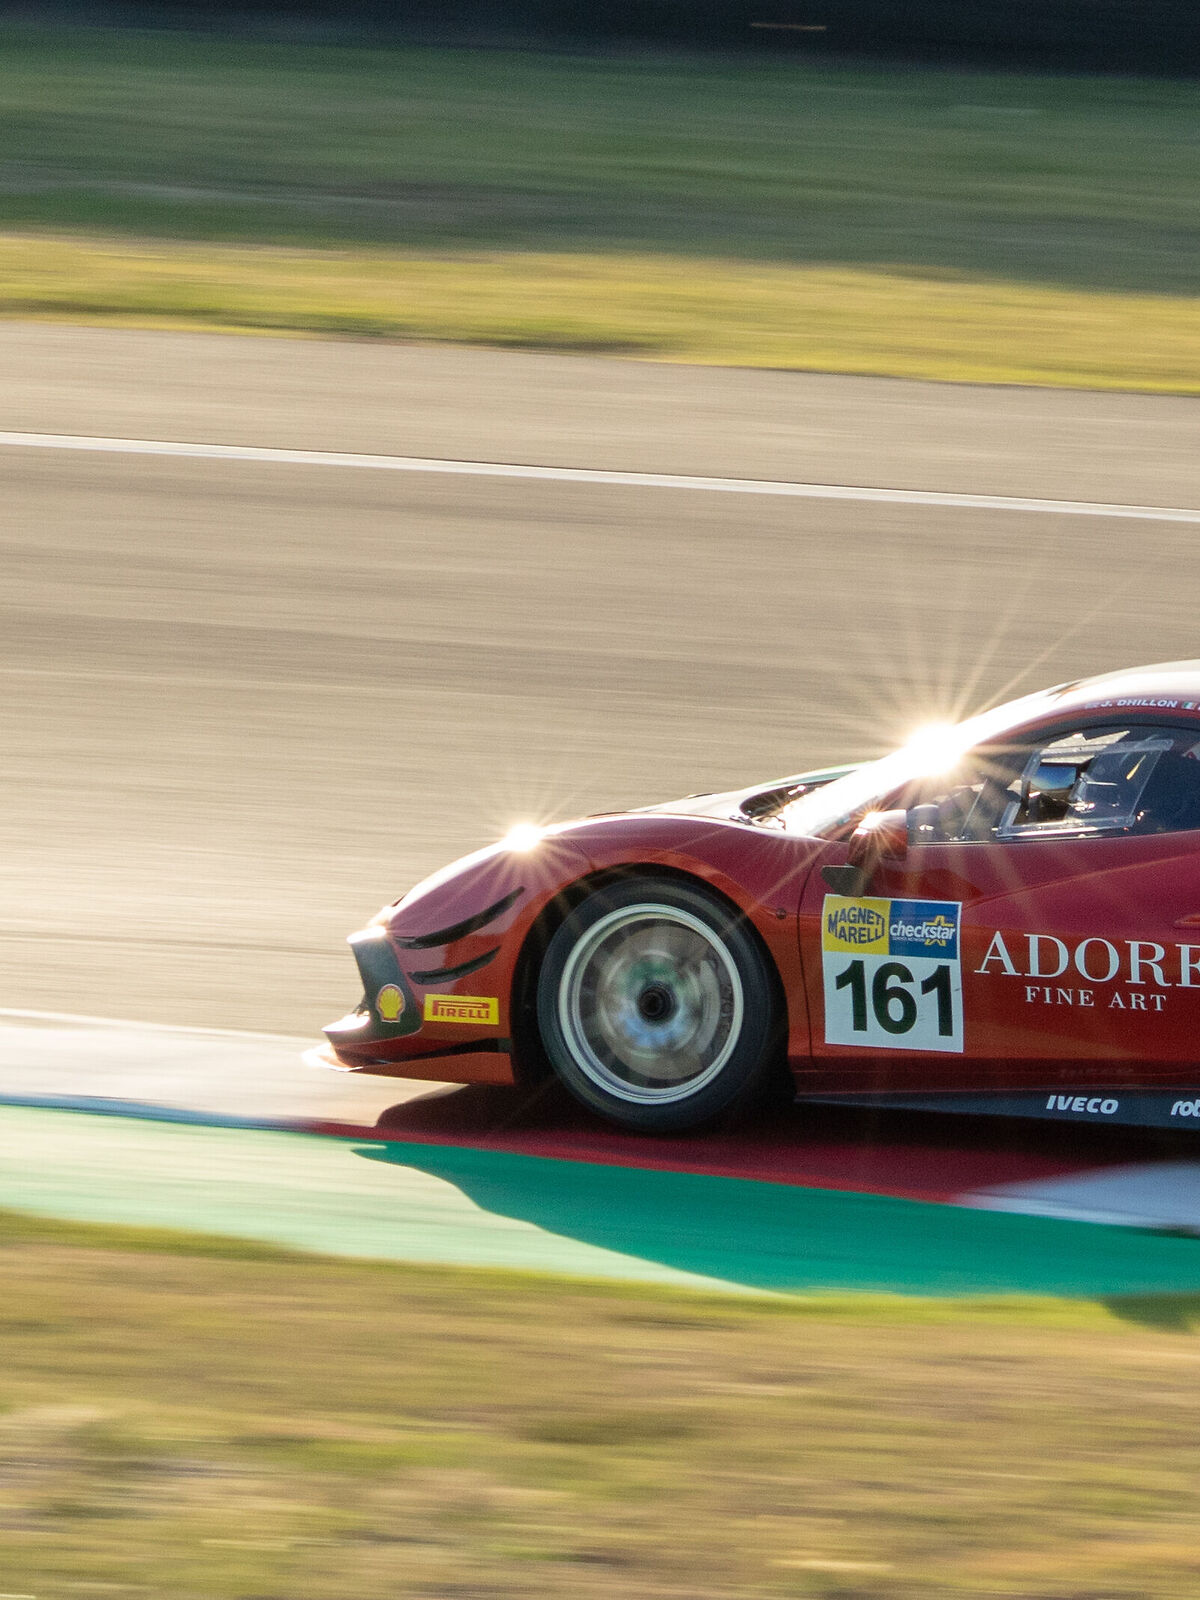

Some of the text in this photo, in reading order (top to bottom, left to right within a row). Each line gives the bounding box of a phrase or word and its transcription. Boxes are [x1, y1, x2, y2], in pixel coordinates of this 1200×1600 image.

[1117, 699, 1178, 708] DHILLON
[889, 920, 955, 939] checkstar
[836, 960, 953, 1037] 161
[1025, 986, 1167, 1011] FINE ART
[432, 1000, 490, 1019] PIRELLI
[1046, 1095, 1119, 1114] IVECO
